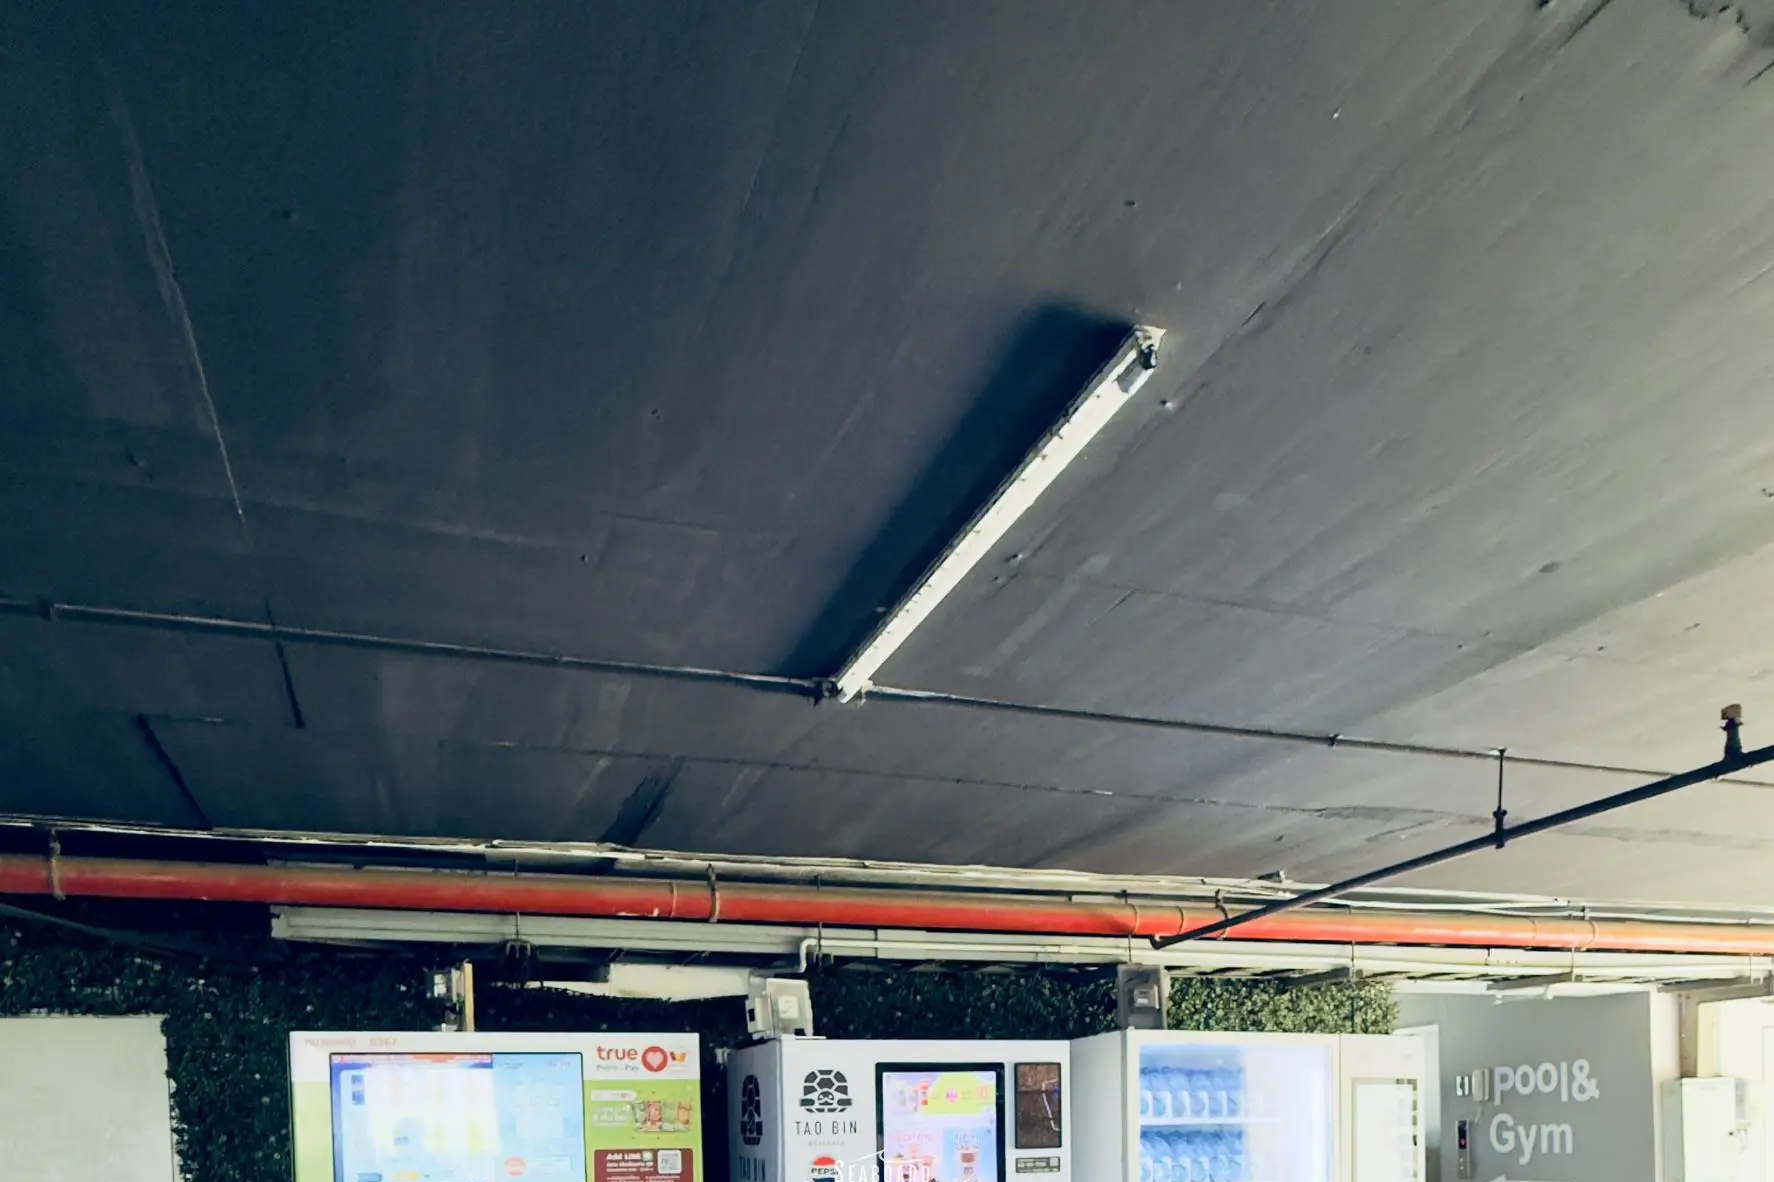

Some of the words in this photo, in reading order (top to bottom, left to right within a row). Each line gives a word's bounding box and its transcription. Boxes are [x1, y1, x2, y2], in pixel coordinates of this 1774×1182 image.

[597, 1045, 638, 1061] true
[795, 1120, 822, 1136] TAO
[832, 1120, 857, 1135] BIN
[1489, 1113, 1573, 1166] Gym
